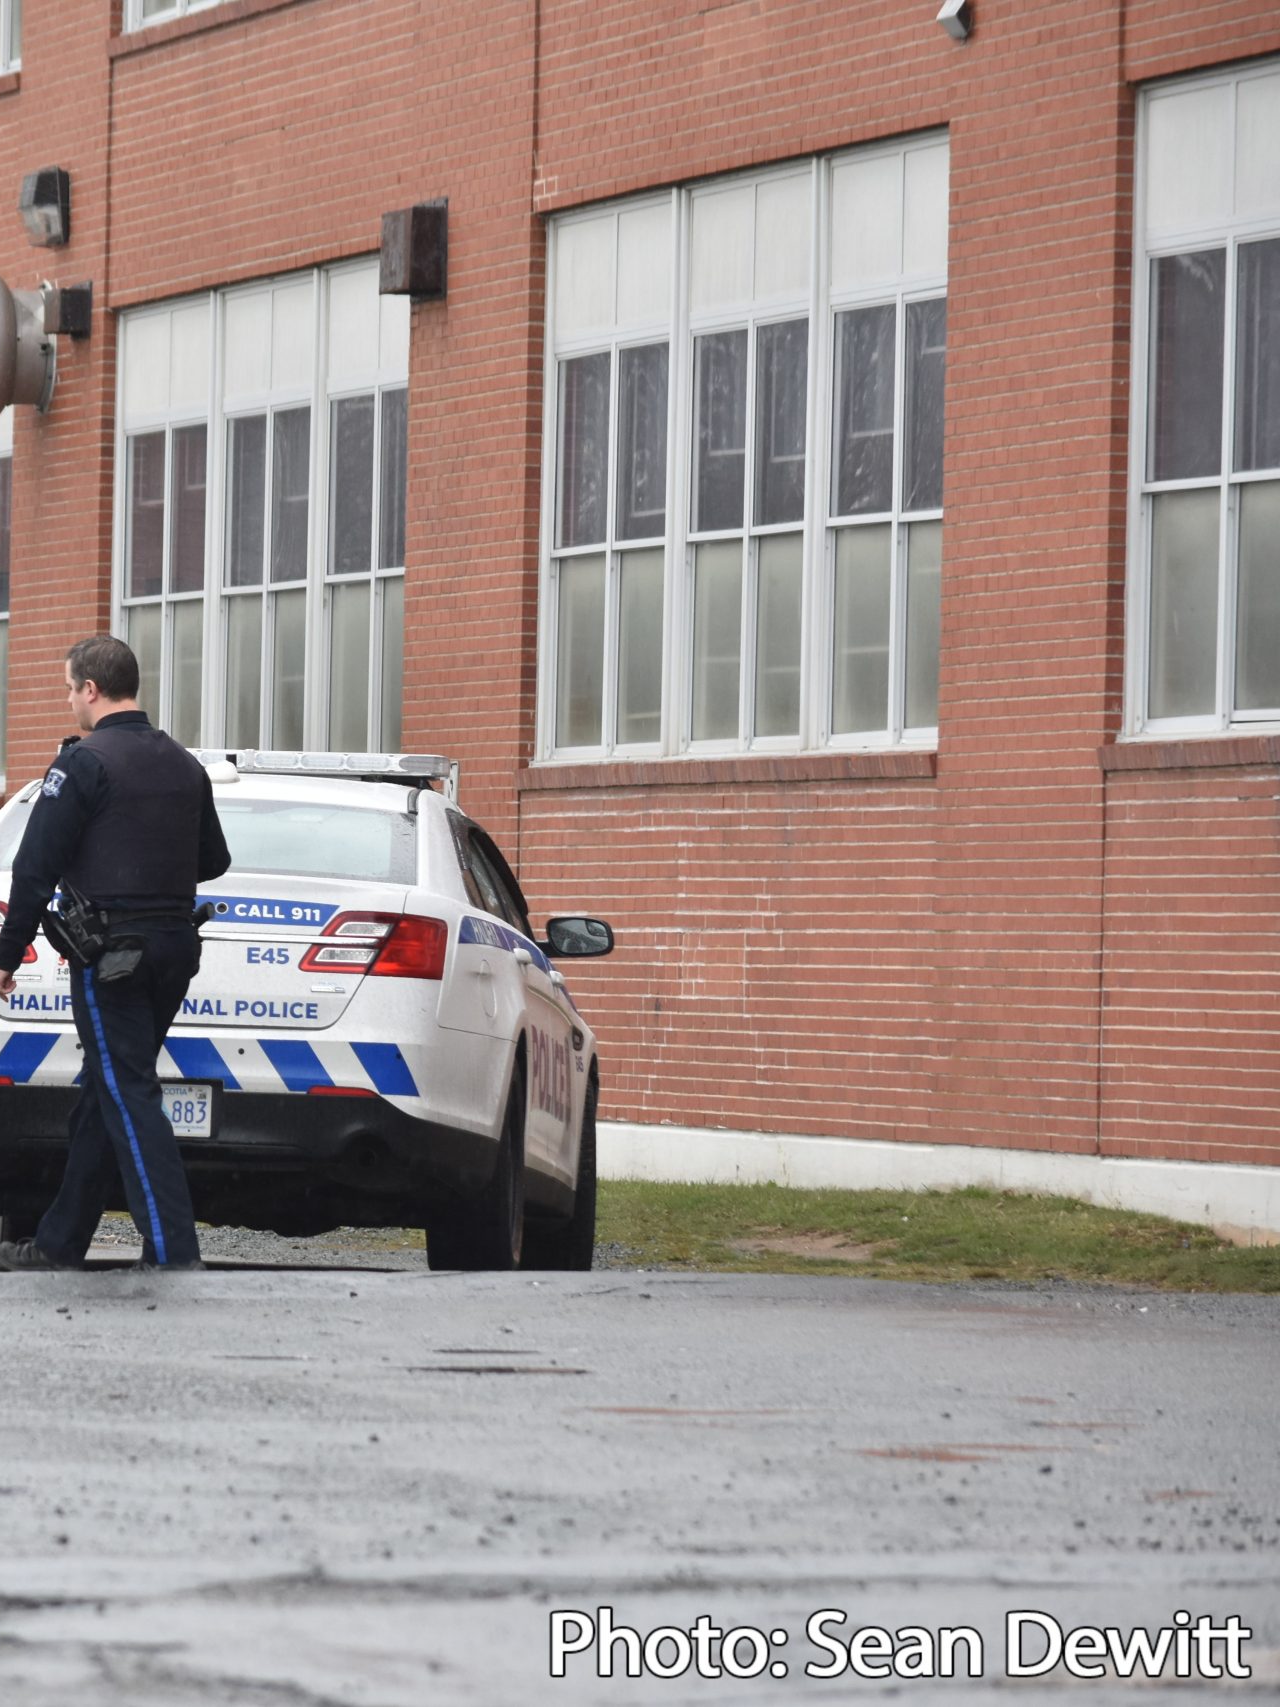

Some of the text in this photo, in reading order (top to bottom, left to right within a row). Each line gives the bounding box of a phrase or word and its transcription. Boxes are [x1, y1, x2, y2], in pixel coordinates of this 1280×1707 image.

[234, 903, 320, 922] CALL 911
[246, 947, 290, 965] E45
[10, 994, 319, 1019] HALIF NAL POLICE
[531, 1024, 564, 1123] POLICE
[163, 1087, 188, 1095] COTIA
[172, 1100, 207, 1124] 883
